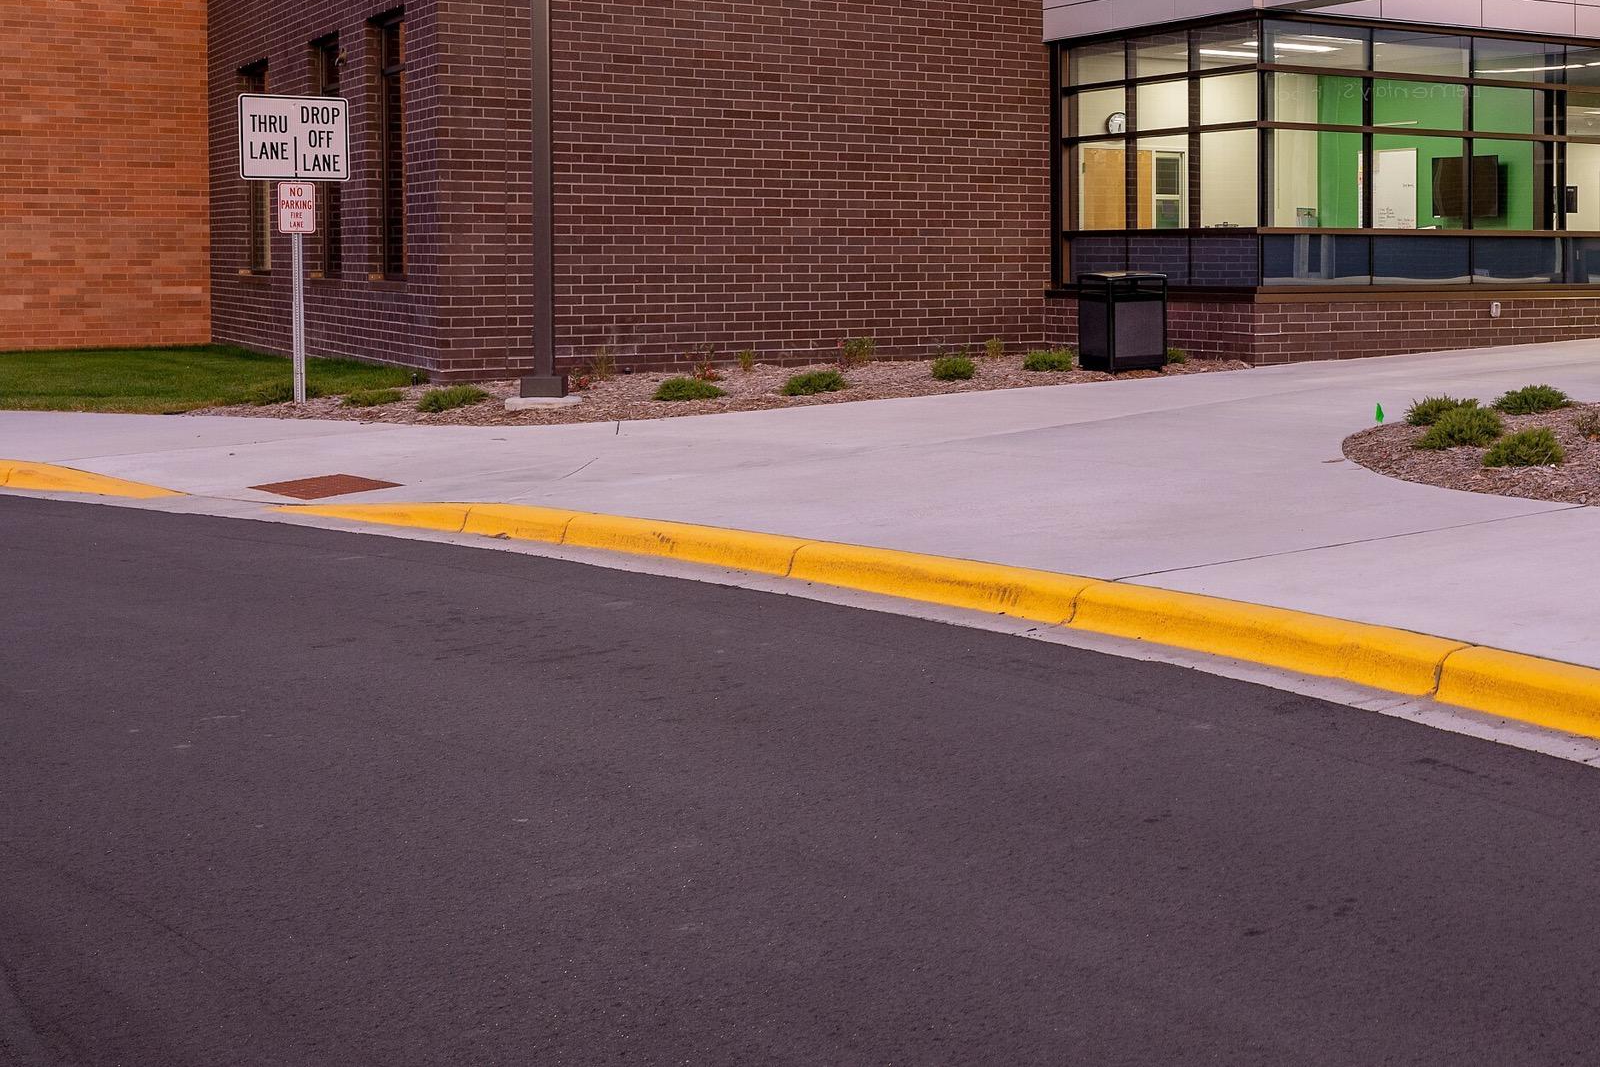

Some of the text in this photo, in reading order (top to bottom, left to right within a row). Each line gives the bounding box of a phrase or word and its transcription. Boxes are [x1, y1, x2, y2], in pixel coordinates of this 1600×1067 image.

[249, 114, 288, 134] THRU
[300, 106, 340, 125] DROP
[308, 129, 334, 148] OFF
[249, 141, 289, 160] LANE
[303, 153, 341, 172] LANE
[289, 187, 303, 197] NO
[281, 199, 312, 211] PARKING
[290, 211, 302, 219] FIRE
